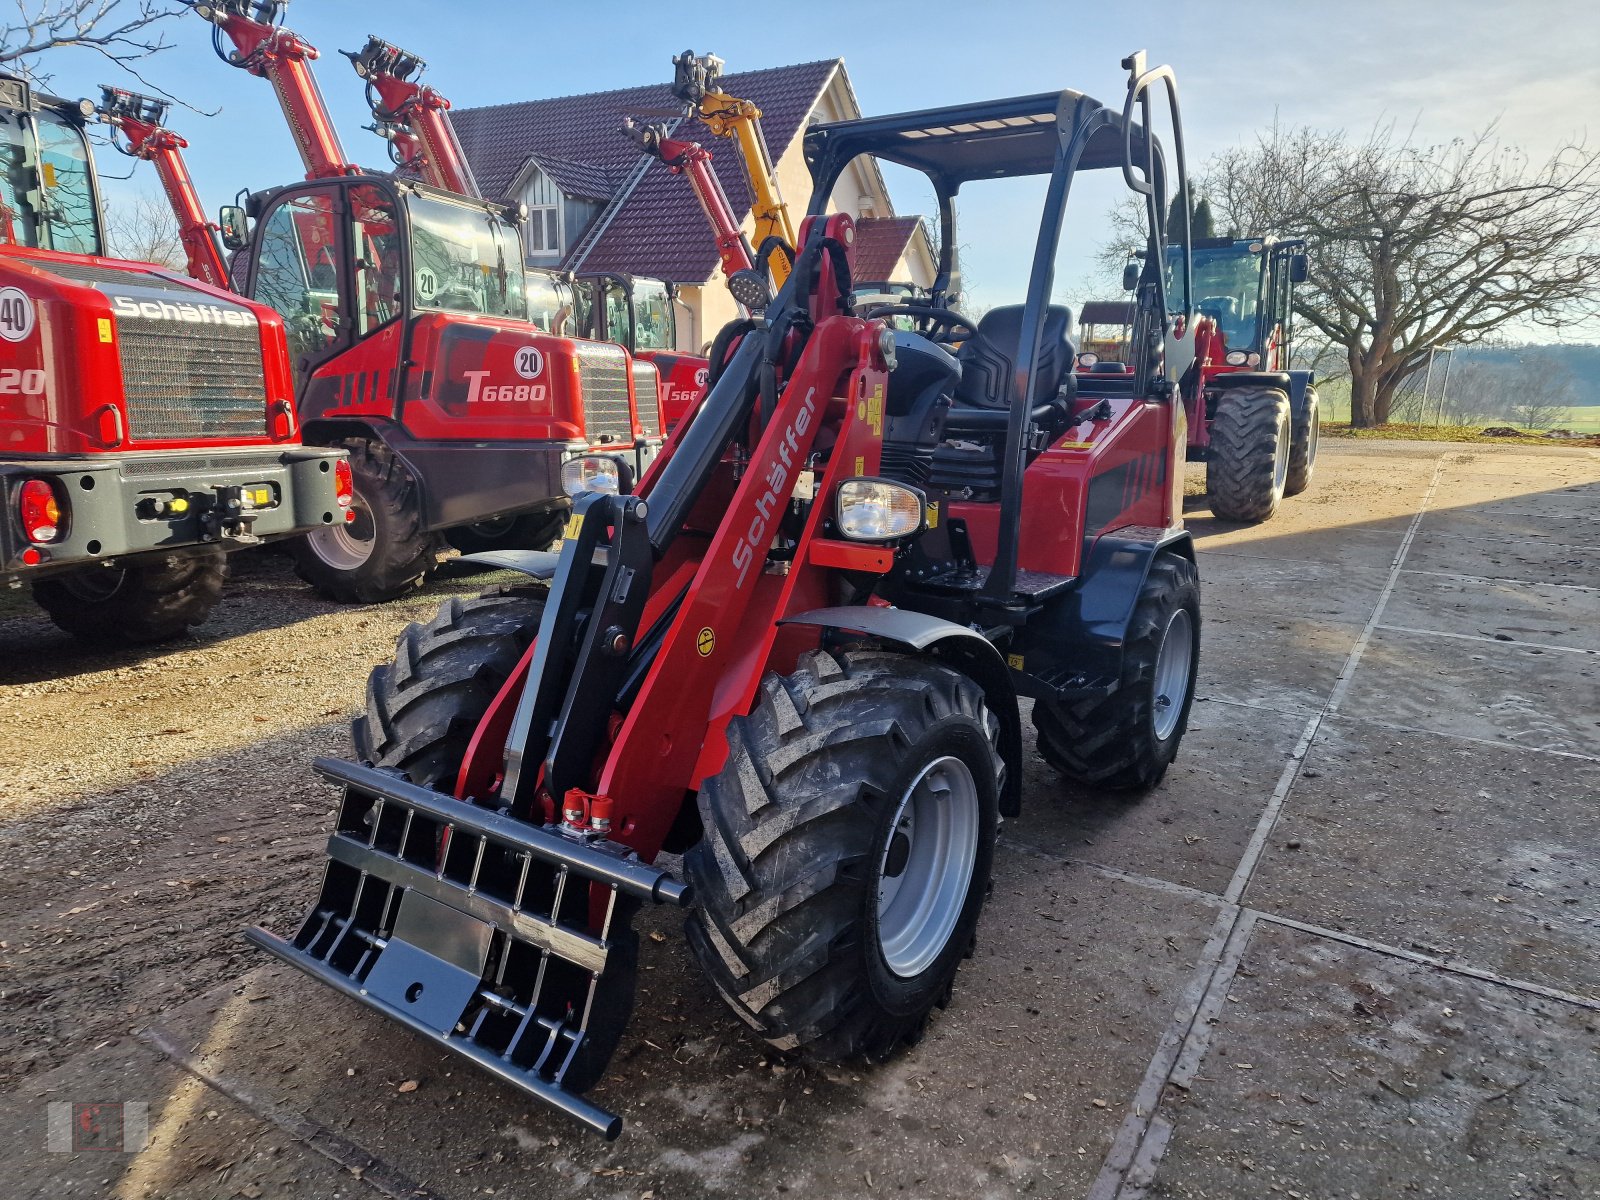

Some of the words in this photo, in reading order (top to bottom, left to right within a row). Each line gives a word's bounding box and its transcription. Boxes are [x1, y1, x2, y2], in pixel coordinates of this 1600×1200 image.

[421, 273, 434, 295] 20
[0, 298, 26, 331] 40
[113, 296, 258, 326] Schäffer
[520, 353, 538, 373] 20
[463, 371, 546, 402] T6680
[732, 386, 815, 589] Schäffer
